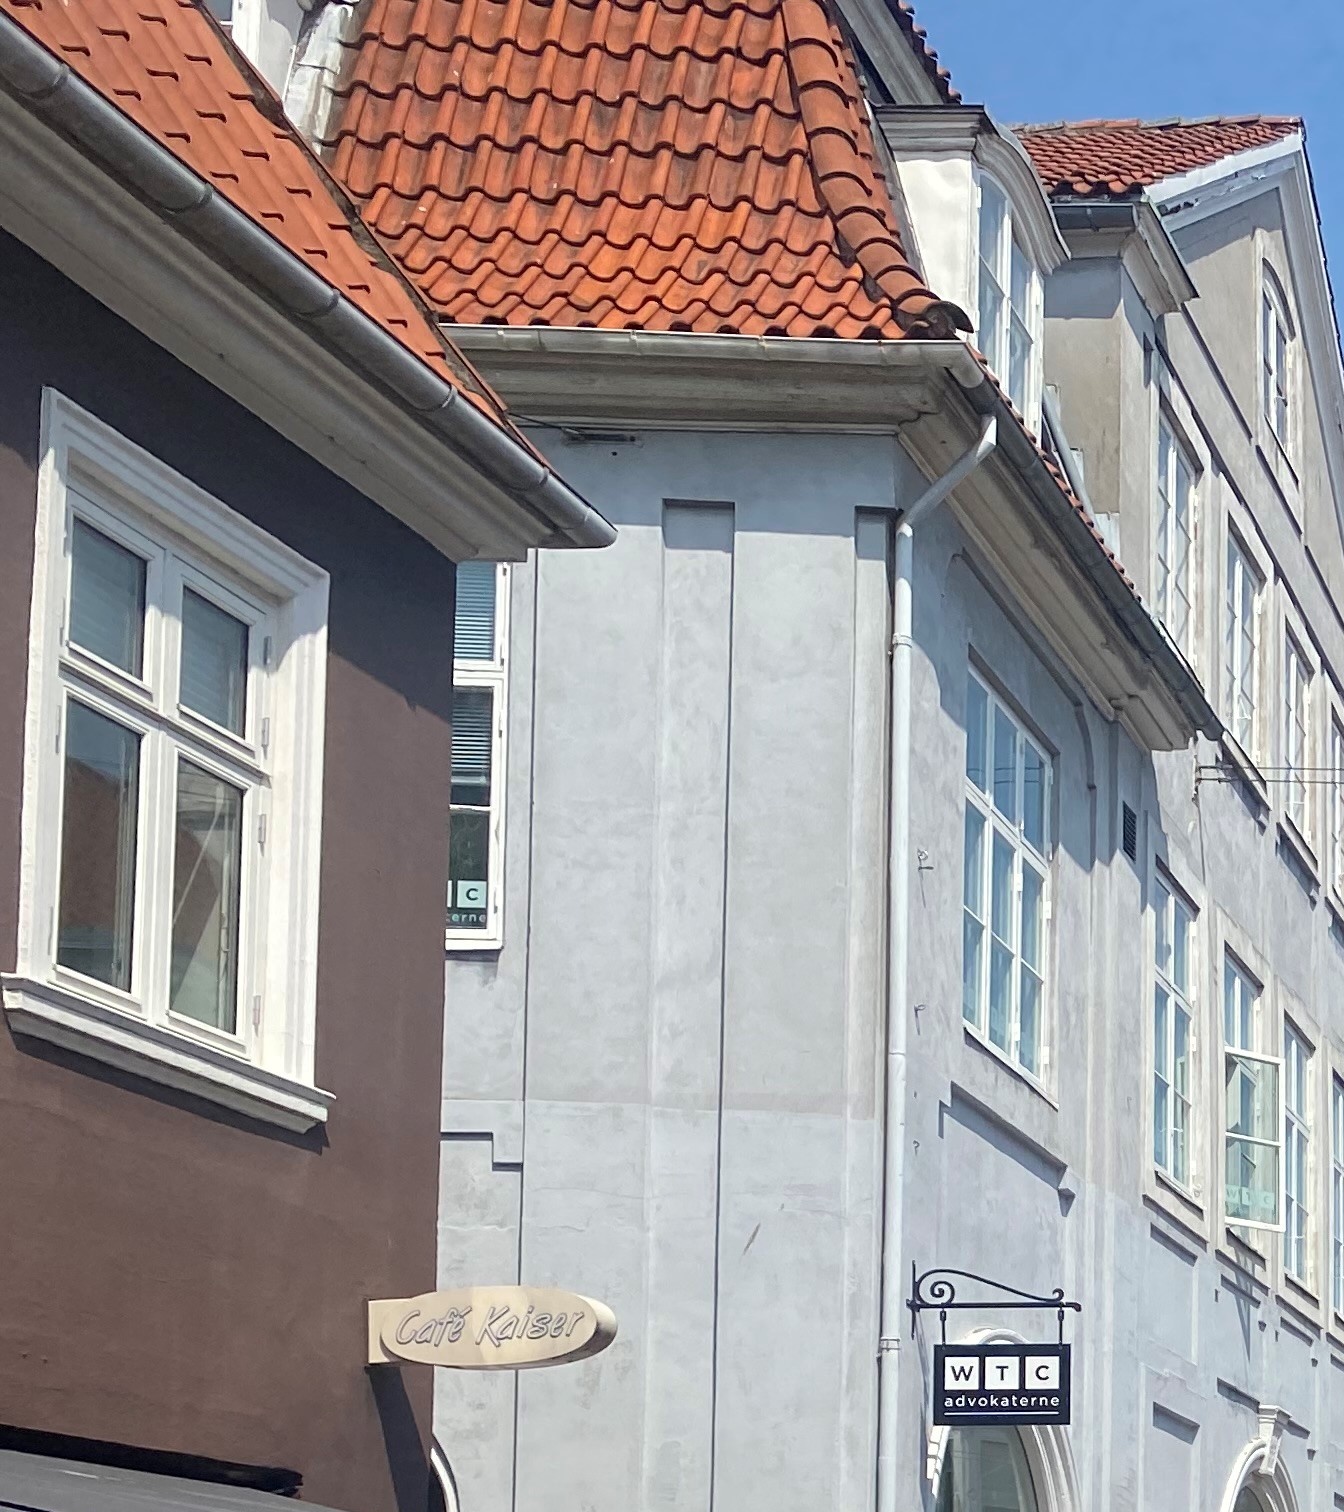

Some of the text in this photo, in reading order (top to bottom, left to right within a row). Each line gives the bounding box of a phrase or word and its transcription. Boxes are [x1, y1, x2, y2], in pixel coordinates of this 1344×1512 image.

[396, 1306, 585, 1348] Café Kaiser
[944, 1395, 1060, 1407] advokaterne
